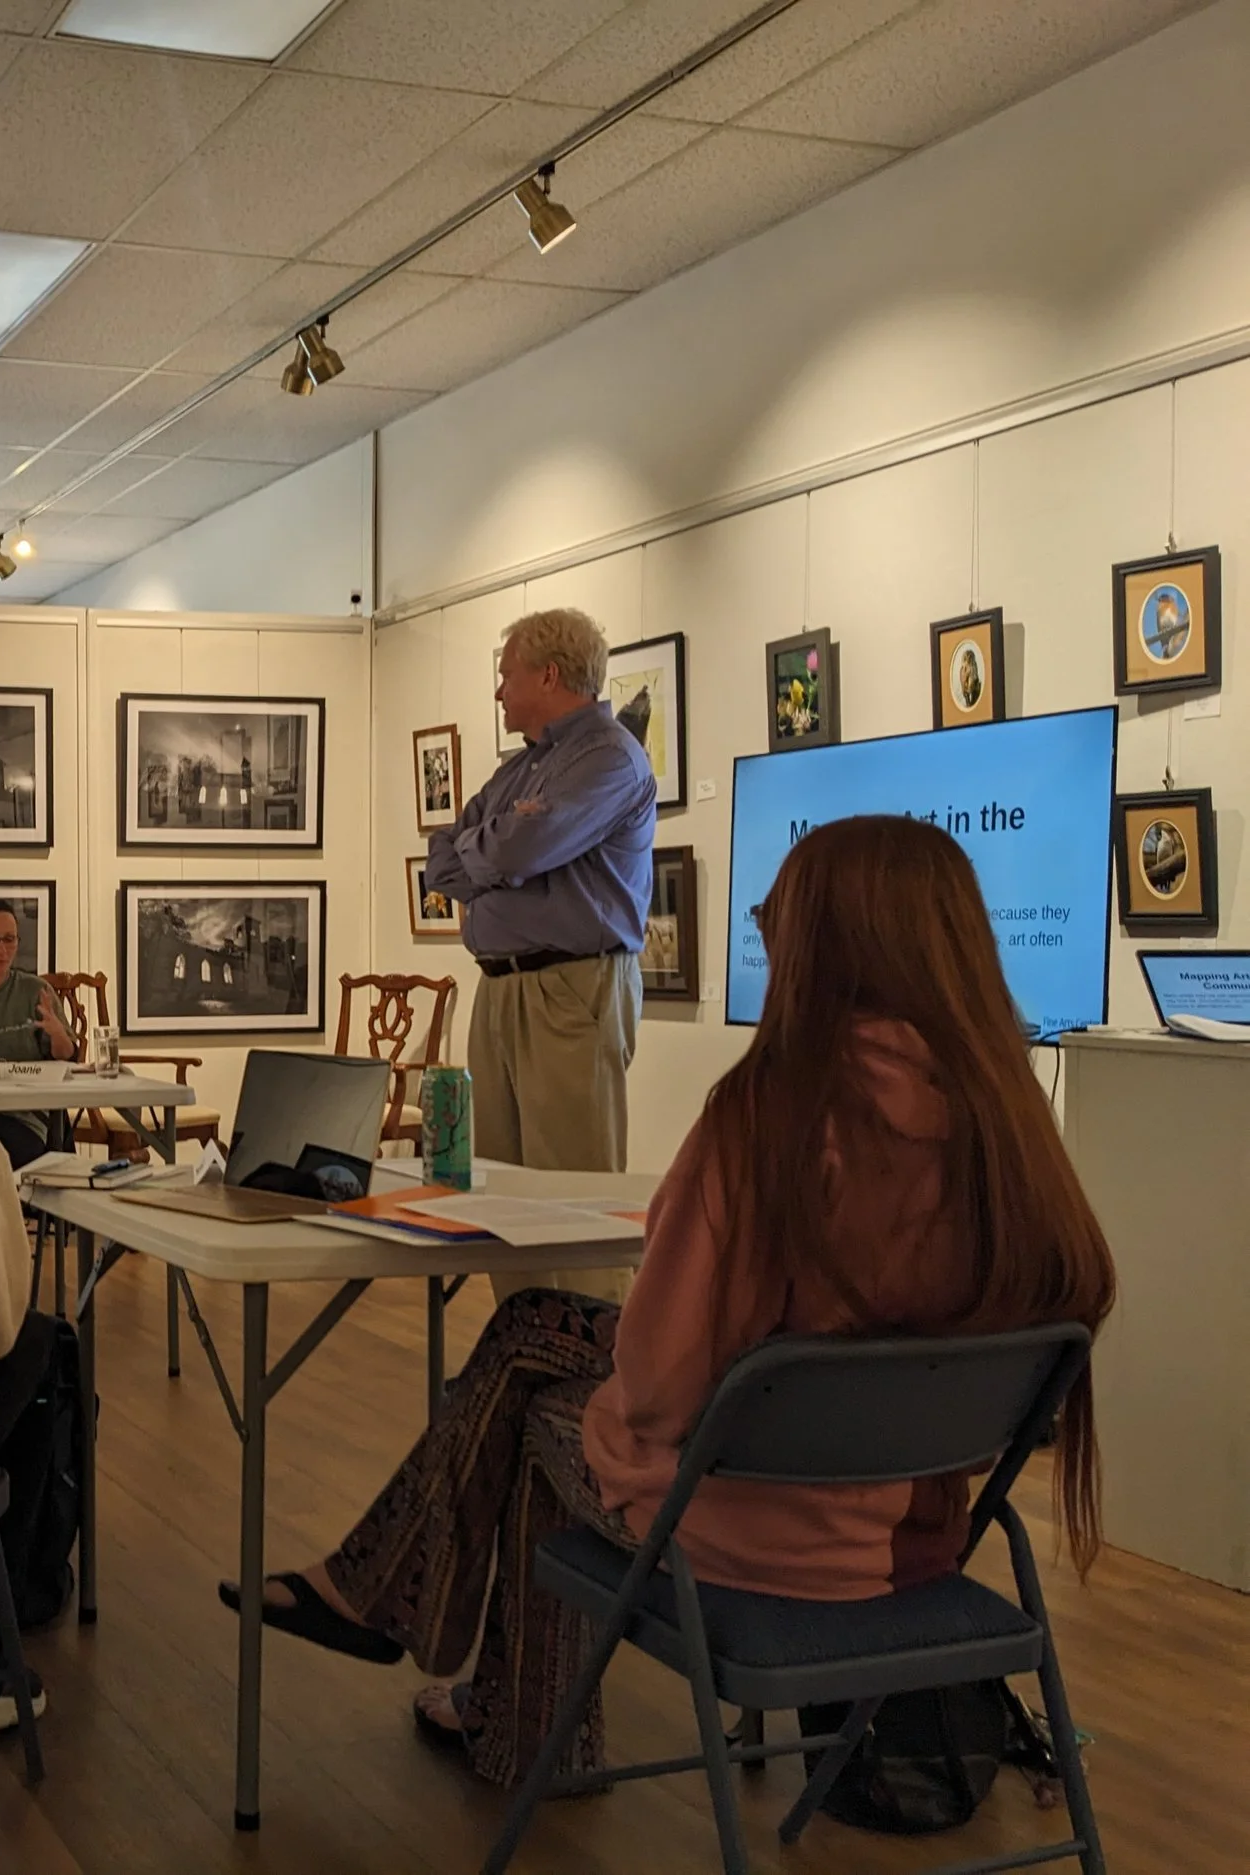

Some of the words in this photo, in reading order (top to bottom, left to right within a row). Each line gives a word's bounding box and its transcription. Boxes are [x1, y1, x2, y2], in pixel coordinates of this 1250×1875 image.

[946, 805, 970, 834] in
[980, 801, 1025, 832] the
[1041, 904, 1071, 923] they
[1008, 933, 1026, 946] art
[1029, 931, 1063, 947] often
[742, 954, 766, 969] happ
[1179, 972, 1229, 981] Mapping
[8, 1064, 42, 1075] Joanie
